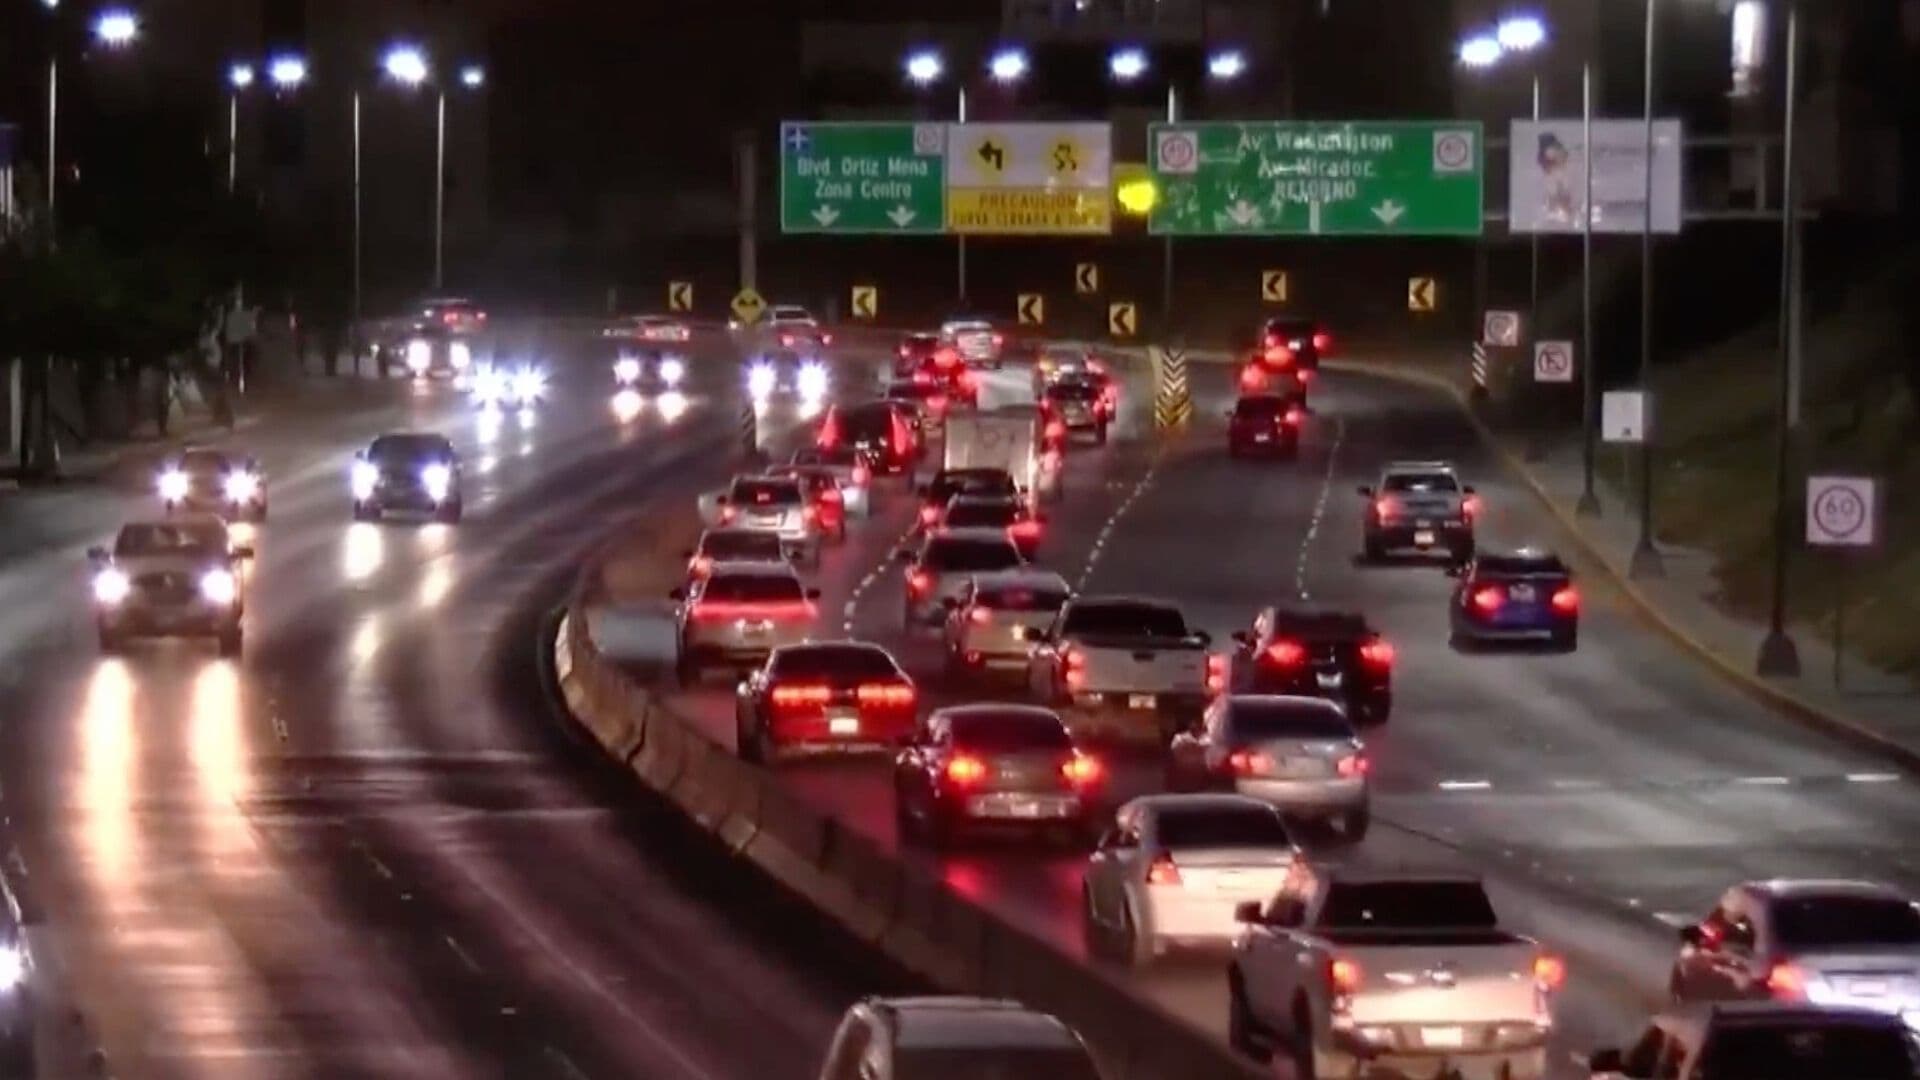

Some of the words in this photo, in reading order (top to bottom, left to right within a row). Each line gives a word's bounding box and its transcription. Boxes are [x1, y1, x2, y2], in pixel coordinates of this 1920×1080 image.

[797, 157, 831, 176] Blvd
[841, 157, 880, 176] Ortiz
[887, 157, 928, 176] Mena
[815, 179, 853, 198] Zona
[860, 180, 912, 199] Centro
[1826, 495, 1855, 517] 60
